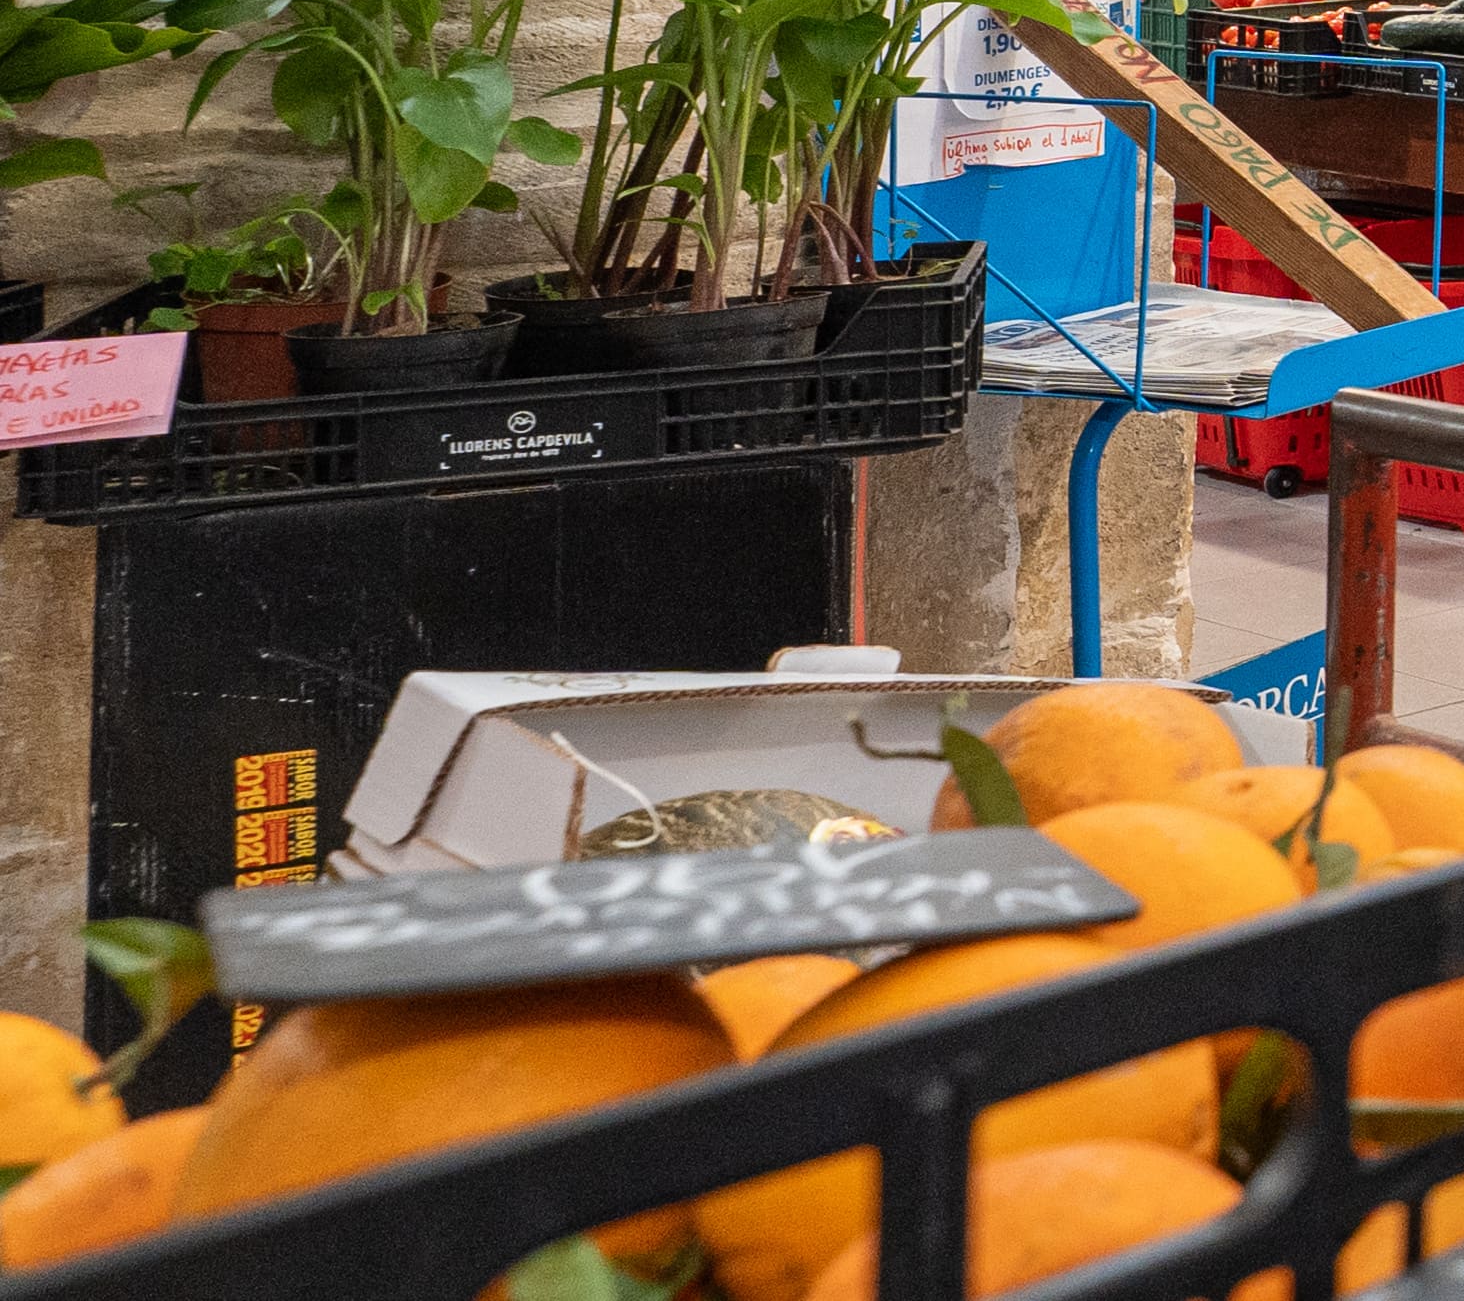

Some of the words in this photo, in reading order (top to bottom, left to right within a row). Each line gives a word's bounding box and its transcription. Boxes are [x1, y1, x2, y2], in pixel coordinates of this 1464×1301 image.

[974, 65, 1052, 87] DIUMENGES
[450, 437, 513, 455] LLORENS
[517, 432, 594, 449] CAPDEVILA
[235, 755, 268, 811] 2019
[294, 757, 318, 801] SABOR
[235, 812, 268, 869] 2020
[294, 814, 318, 859] SABOR
